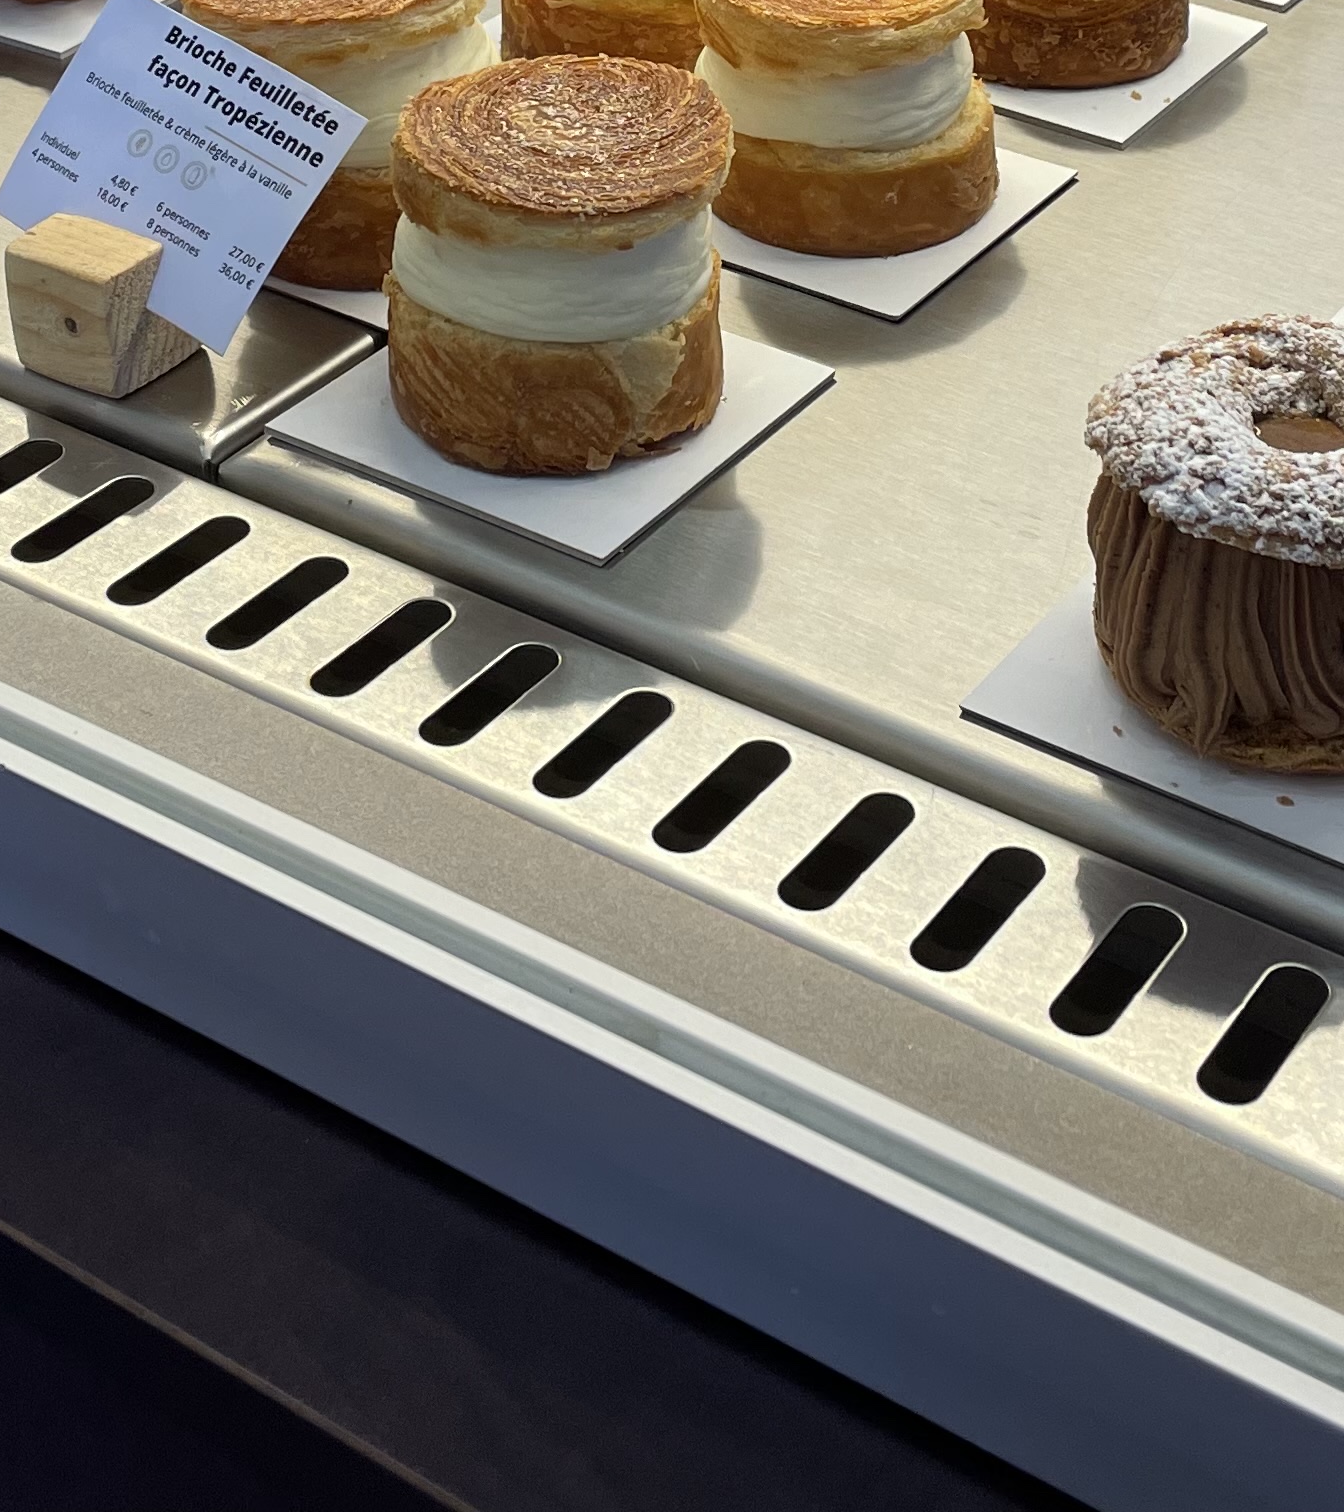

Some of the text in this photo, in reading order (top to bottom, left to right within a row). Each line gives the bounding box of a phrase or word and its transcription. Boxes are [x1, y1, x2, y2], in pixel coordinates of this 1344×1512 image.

[86, 71, 293, 199] Brioche feuilletée & crème légère à la vanille
[147, 54, 324, 168] façon Tropézienne
[165, 25, 339, 136] Brioche Feuilletée
[32, 148, 255, 290] 4 personnes 18,00 € 8 personnes 36,00 €
[40, 131, 265, 273] Individuel 4,80 € 6 personnes 27,00 €
